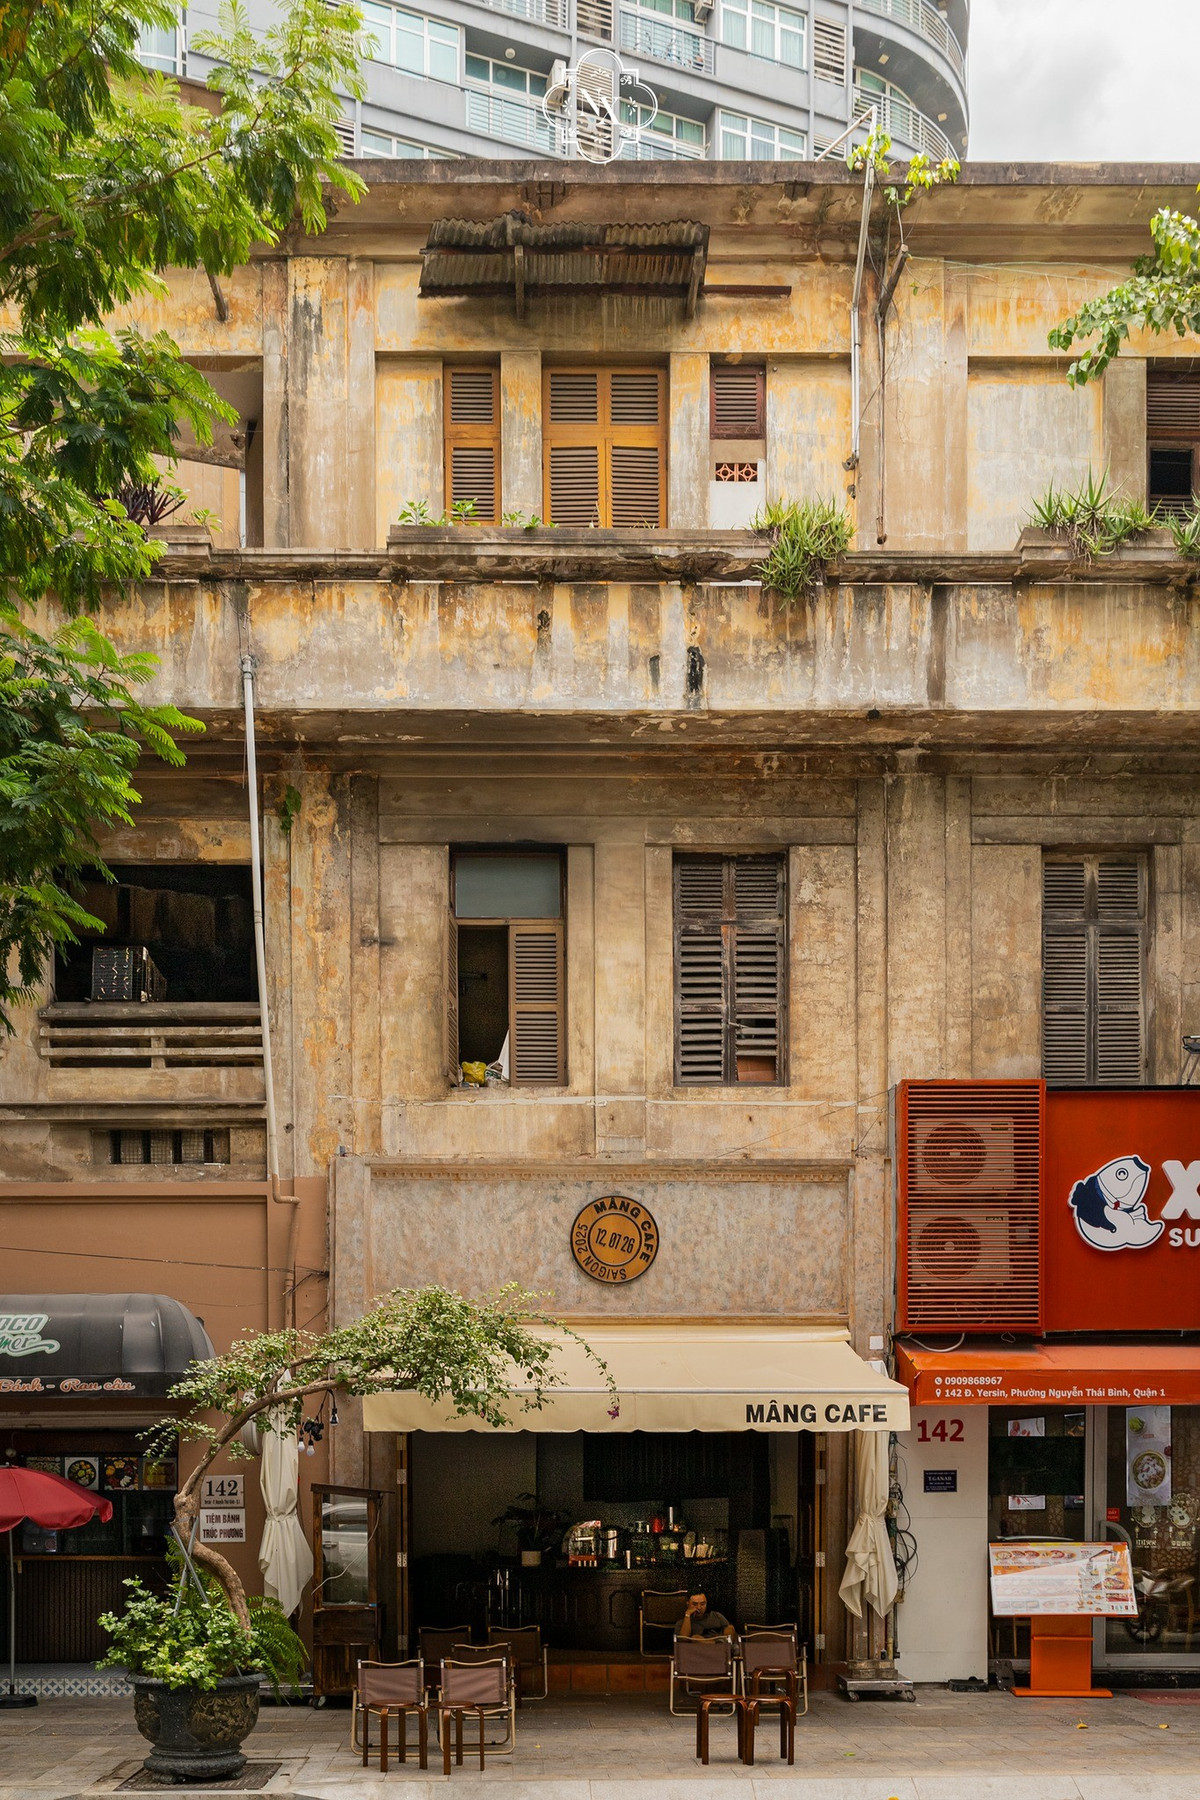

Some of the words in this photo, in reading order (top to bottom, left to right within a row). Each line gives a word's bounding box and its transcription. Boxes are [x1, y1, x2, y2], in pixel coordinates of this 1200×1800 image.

[575, 1223, 589, 1254] 2025
[593, 1197, 641, 1219] MÂNG
[640, 1220, 655, 1263] CAFE
[1169, 1228, 1200, 1247] SU
[582, 1255, 627, 1280] SAIGON
[60, 1378, 102, 1392] Rau
[103, 1378, 136, 1391] câu
[944, 1376, 1003, 1385] 0909868967
[945, 1389, 962, 1397] 142
[977, 1389, 1008, 1398] Yersin,
[1011, 1388, 1046, 1399] Phường
[1048, 1386, 1083, 1398] Nguyễn
[1085, 1388, 1105, 1397] Thái
[1107, 1387, 1131, 1398] Bình,
[1133, 1387, 1158, 1398] Quận
[1160, 1389, 1166, 1397] 1
[746, 1400, 817, 1423] MÂNG
[824, 1404, 888, 1423] CAFE
[917, 1419, 964, 1442] 142
[206, 1480, 238, 1496] 142
[223, 1512, 240, 1524] BÁNH
[203, 1527, 218, 1538] TRÚC
